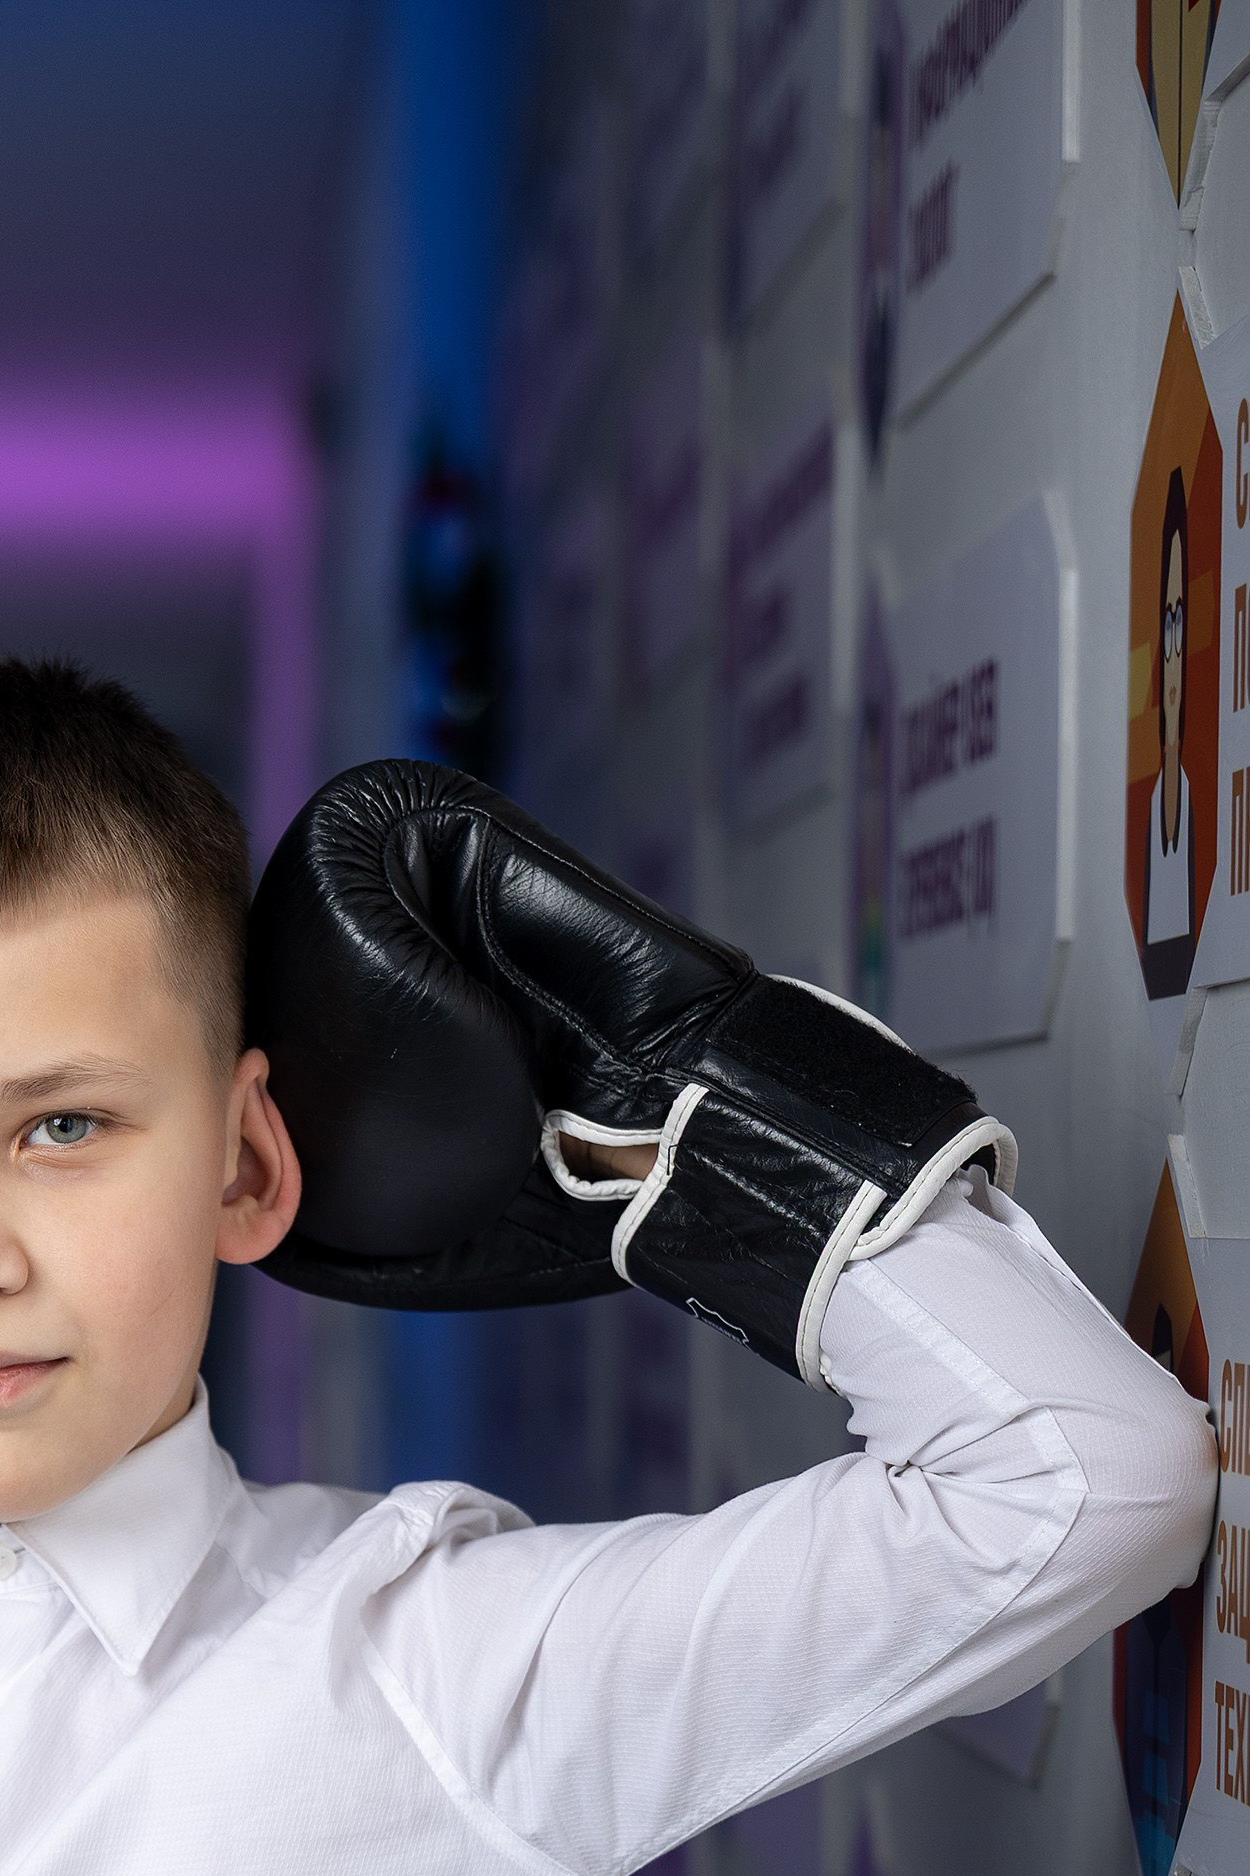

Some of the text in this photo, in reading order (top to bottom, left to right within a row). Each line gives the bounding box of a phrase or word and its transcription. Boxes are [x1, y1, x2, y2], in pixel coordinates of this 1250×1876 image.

[1236, 399, 1250, 529] С
[1233, 583, 1250, 713] П
[1215, 1681, 1250, 1806] ТЕХ
